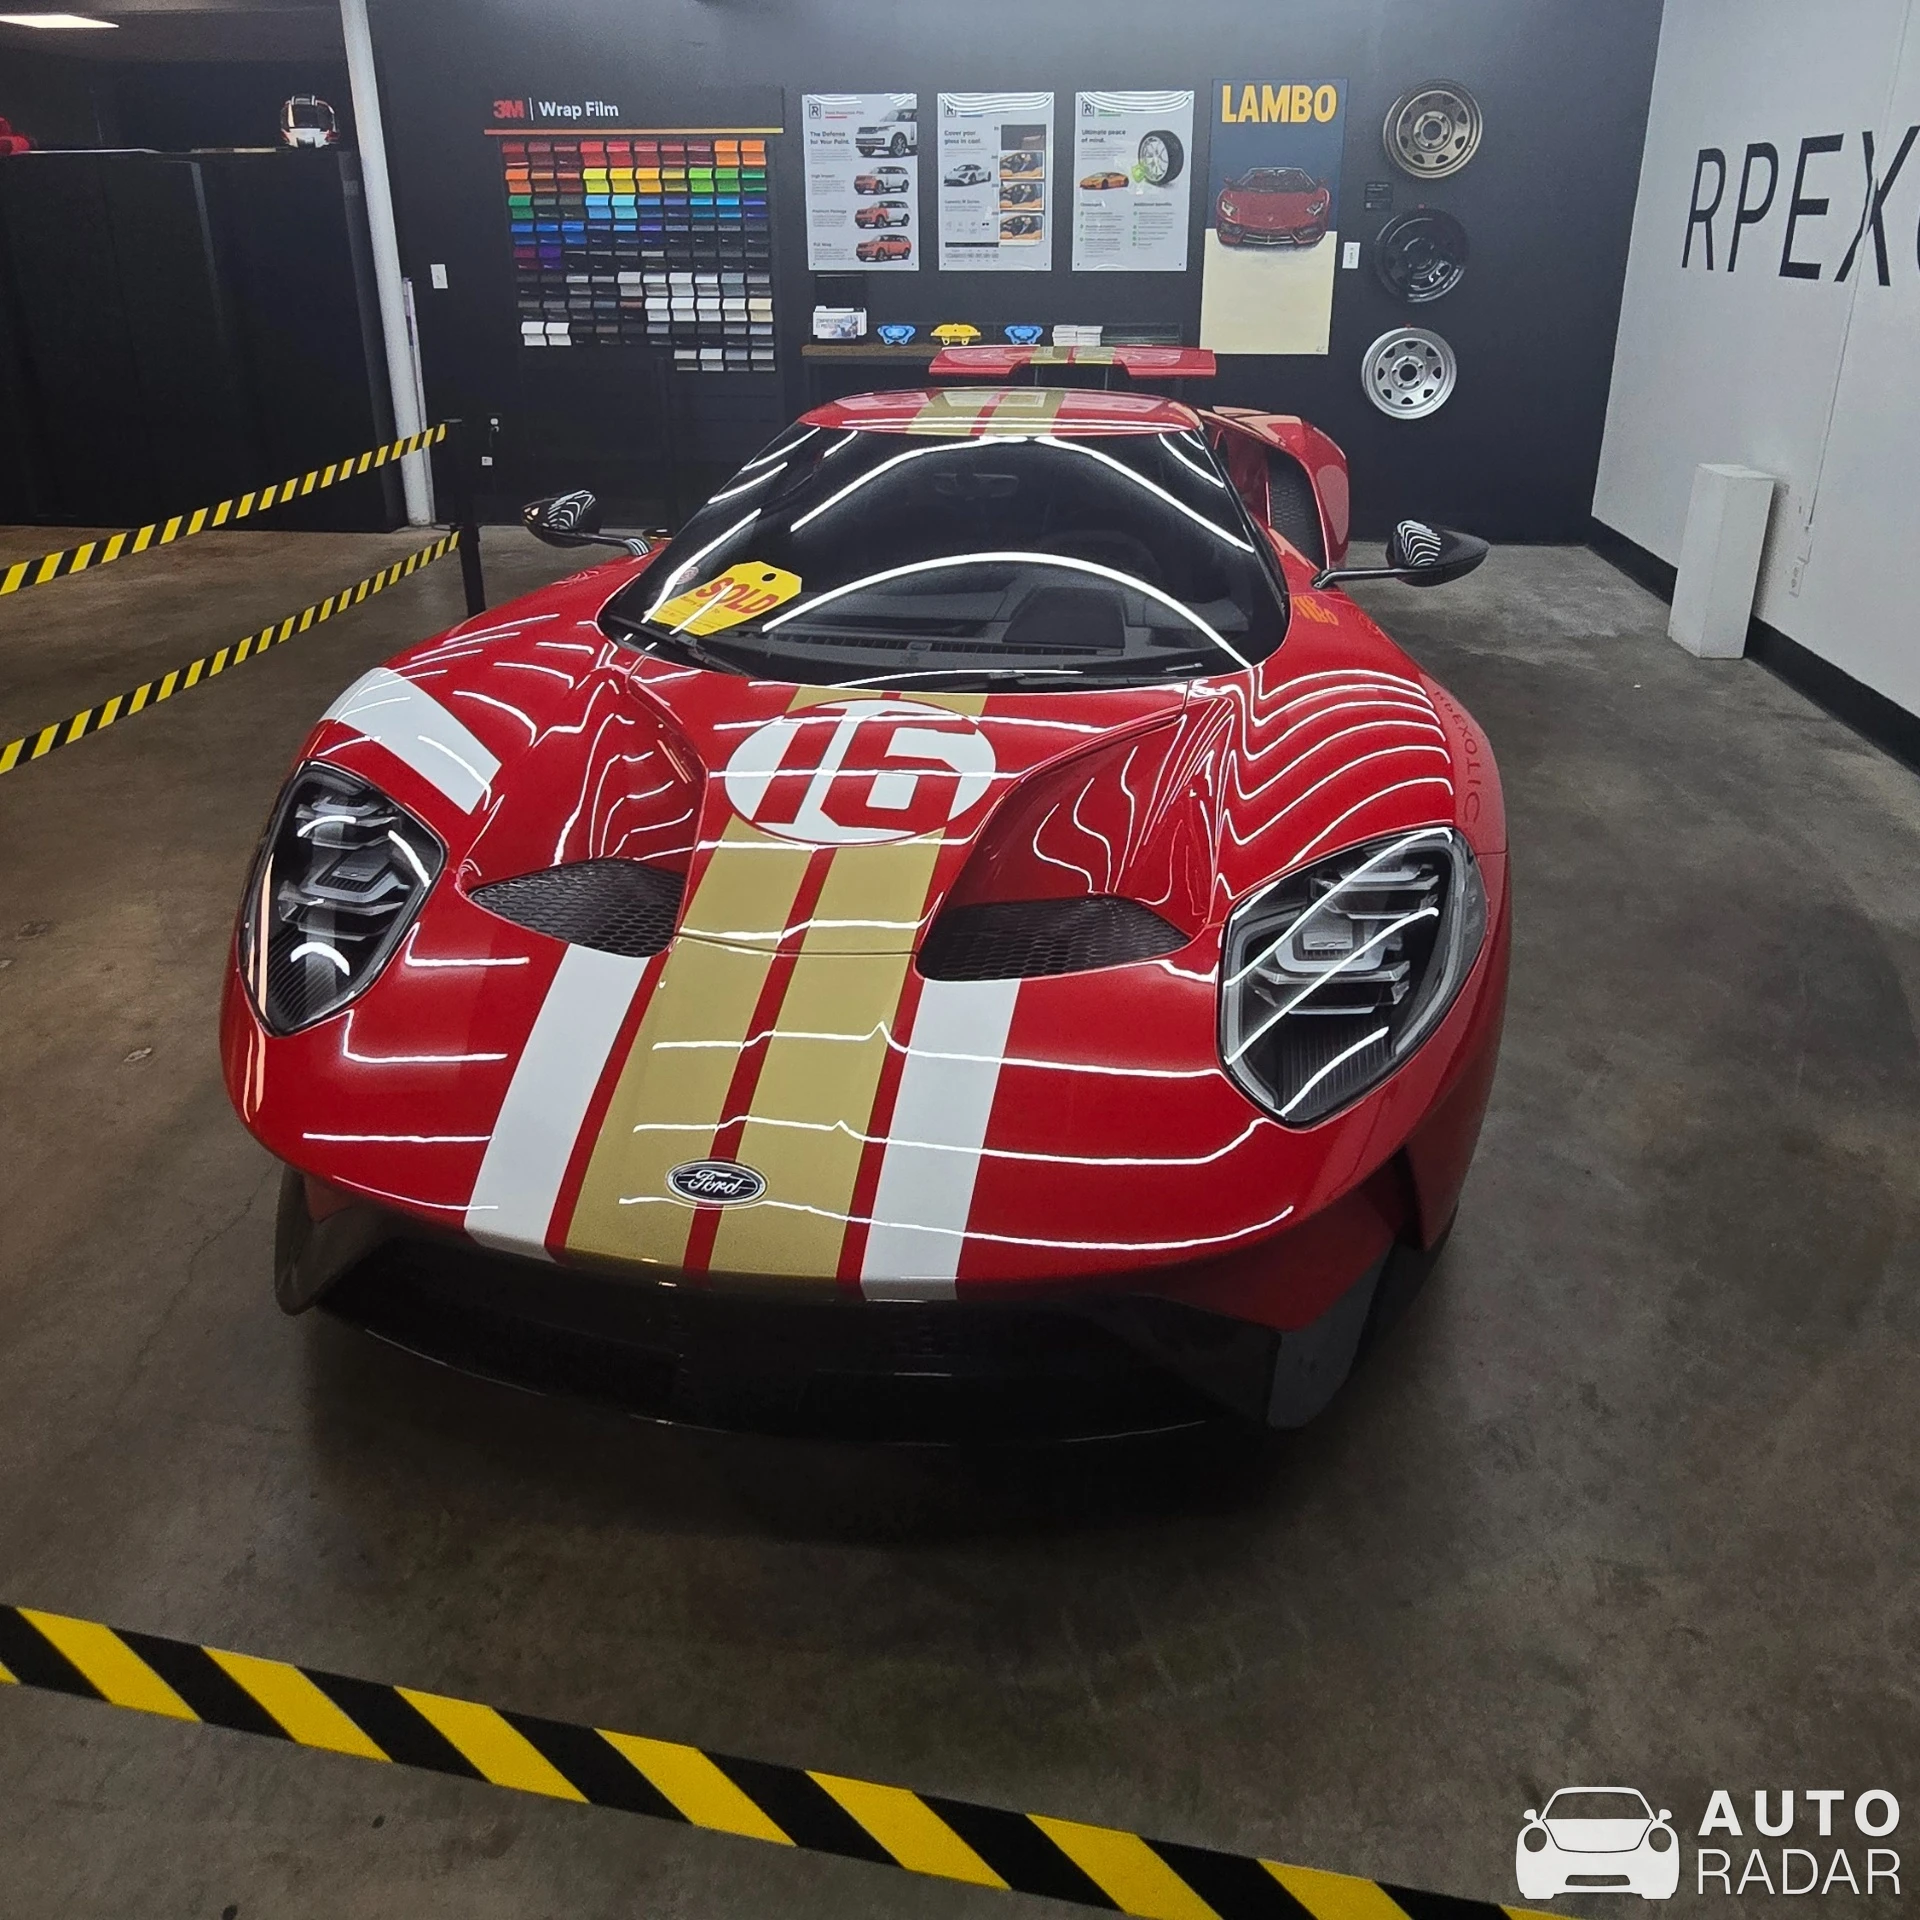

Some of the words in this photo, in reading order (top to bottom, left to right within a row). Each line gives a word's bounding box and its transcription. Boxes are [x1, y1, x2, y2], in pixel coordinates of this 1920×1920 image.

[493, 100, 525, 118] 3M
[538, 101, 582, 120] Wrap
[585, 101, 619, 117] Film
[1221, 84, 1337, 123] LAMBO
[1682, 125, 1920, 286] RPEX
[695, 577, 780, 614] SOLD
[751, 706, 979, 835] 16
[688, 1169, 745, 1196] Ford
